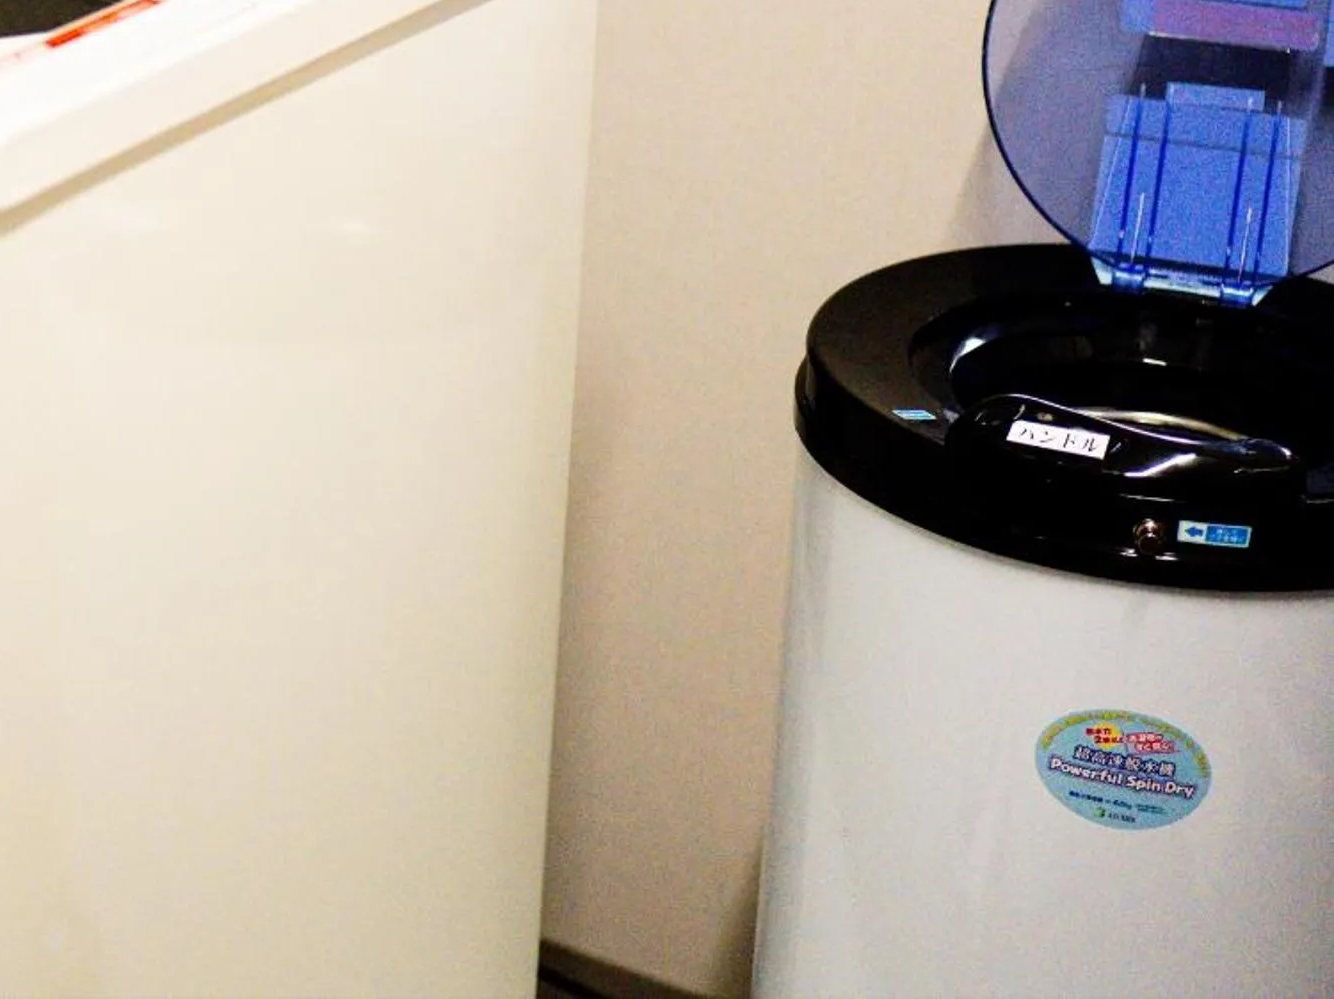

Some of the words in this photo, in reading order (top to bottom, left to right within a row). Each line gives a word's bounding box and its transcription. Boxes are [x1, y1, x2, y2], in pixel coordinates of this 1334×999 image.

[1020, 428, 1098, 452] ハンドル
[1050, 757, 1123, 785] Powerful
[1125, 774, 1162, 792] Spin
[1164, 780, 1196, 800] Dry
